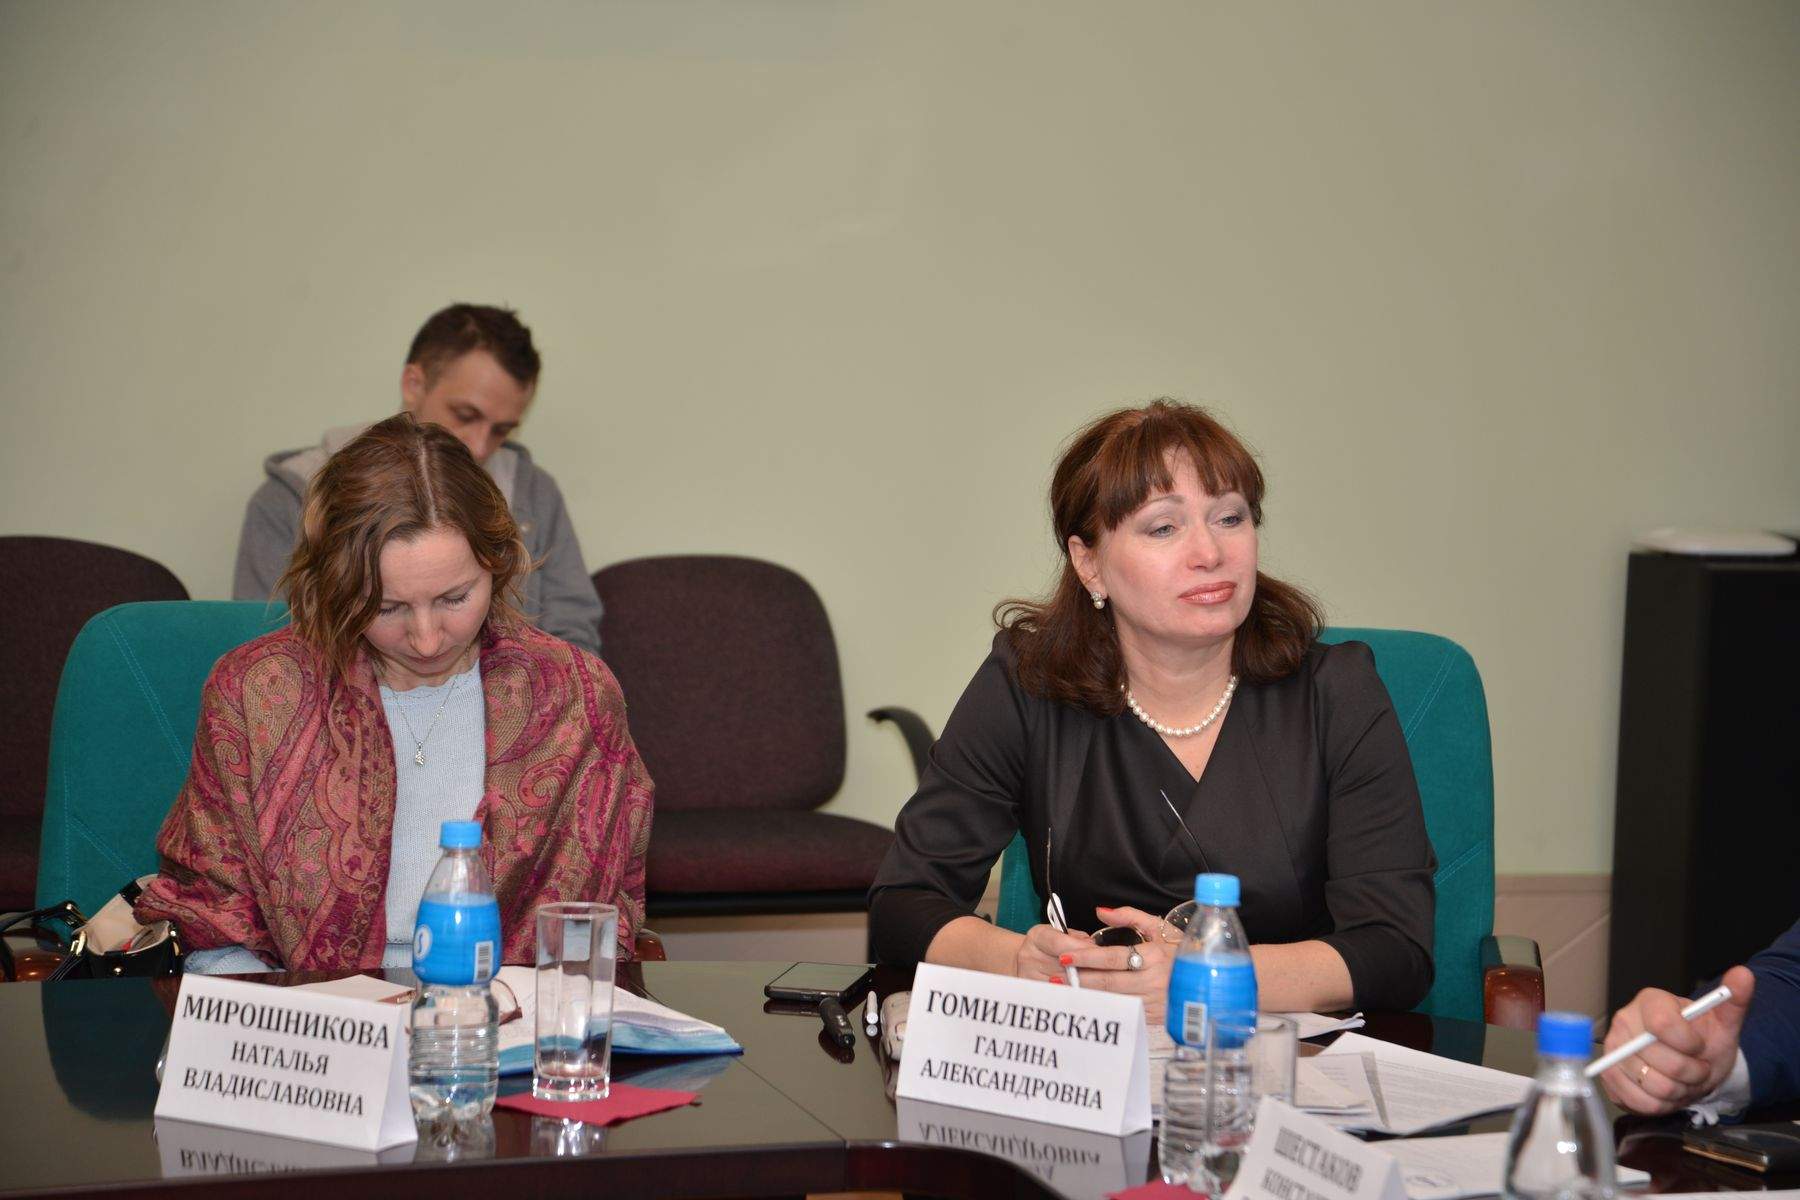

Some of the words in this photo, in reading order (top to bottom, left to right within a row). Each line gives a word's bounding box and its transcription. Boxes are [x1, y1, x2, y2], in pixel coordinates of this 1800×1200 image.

[182, 994, 390, 1049] МИРОШНИКОВА
[926, 989, 1122, 1046] ГОМИЛЕВСКАЯ
[230, 1041, 330, 1075] НАТАЛЬЯ
[973, 1035, 1060, 1069] ГАЛИНА
[182, 1067, 364, 1116] ВЛАДИСЛАВОВНА
[920, 1058, 1103, 1110] АЛЕКСАНДРОВНА
